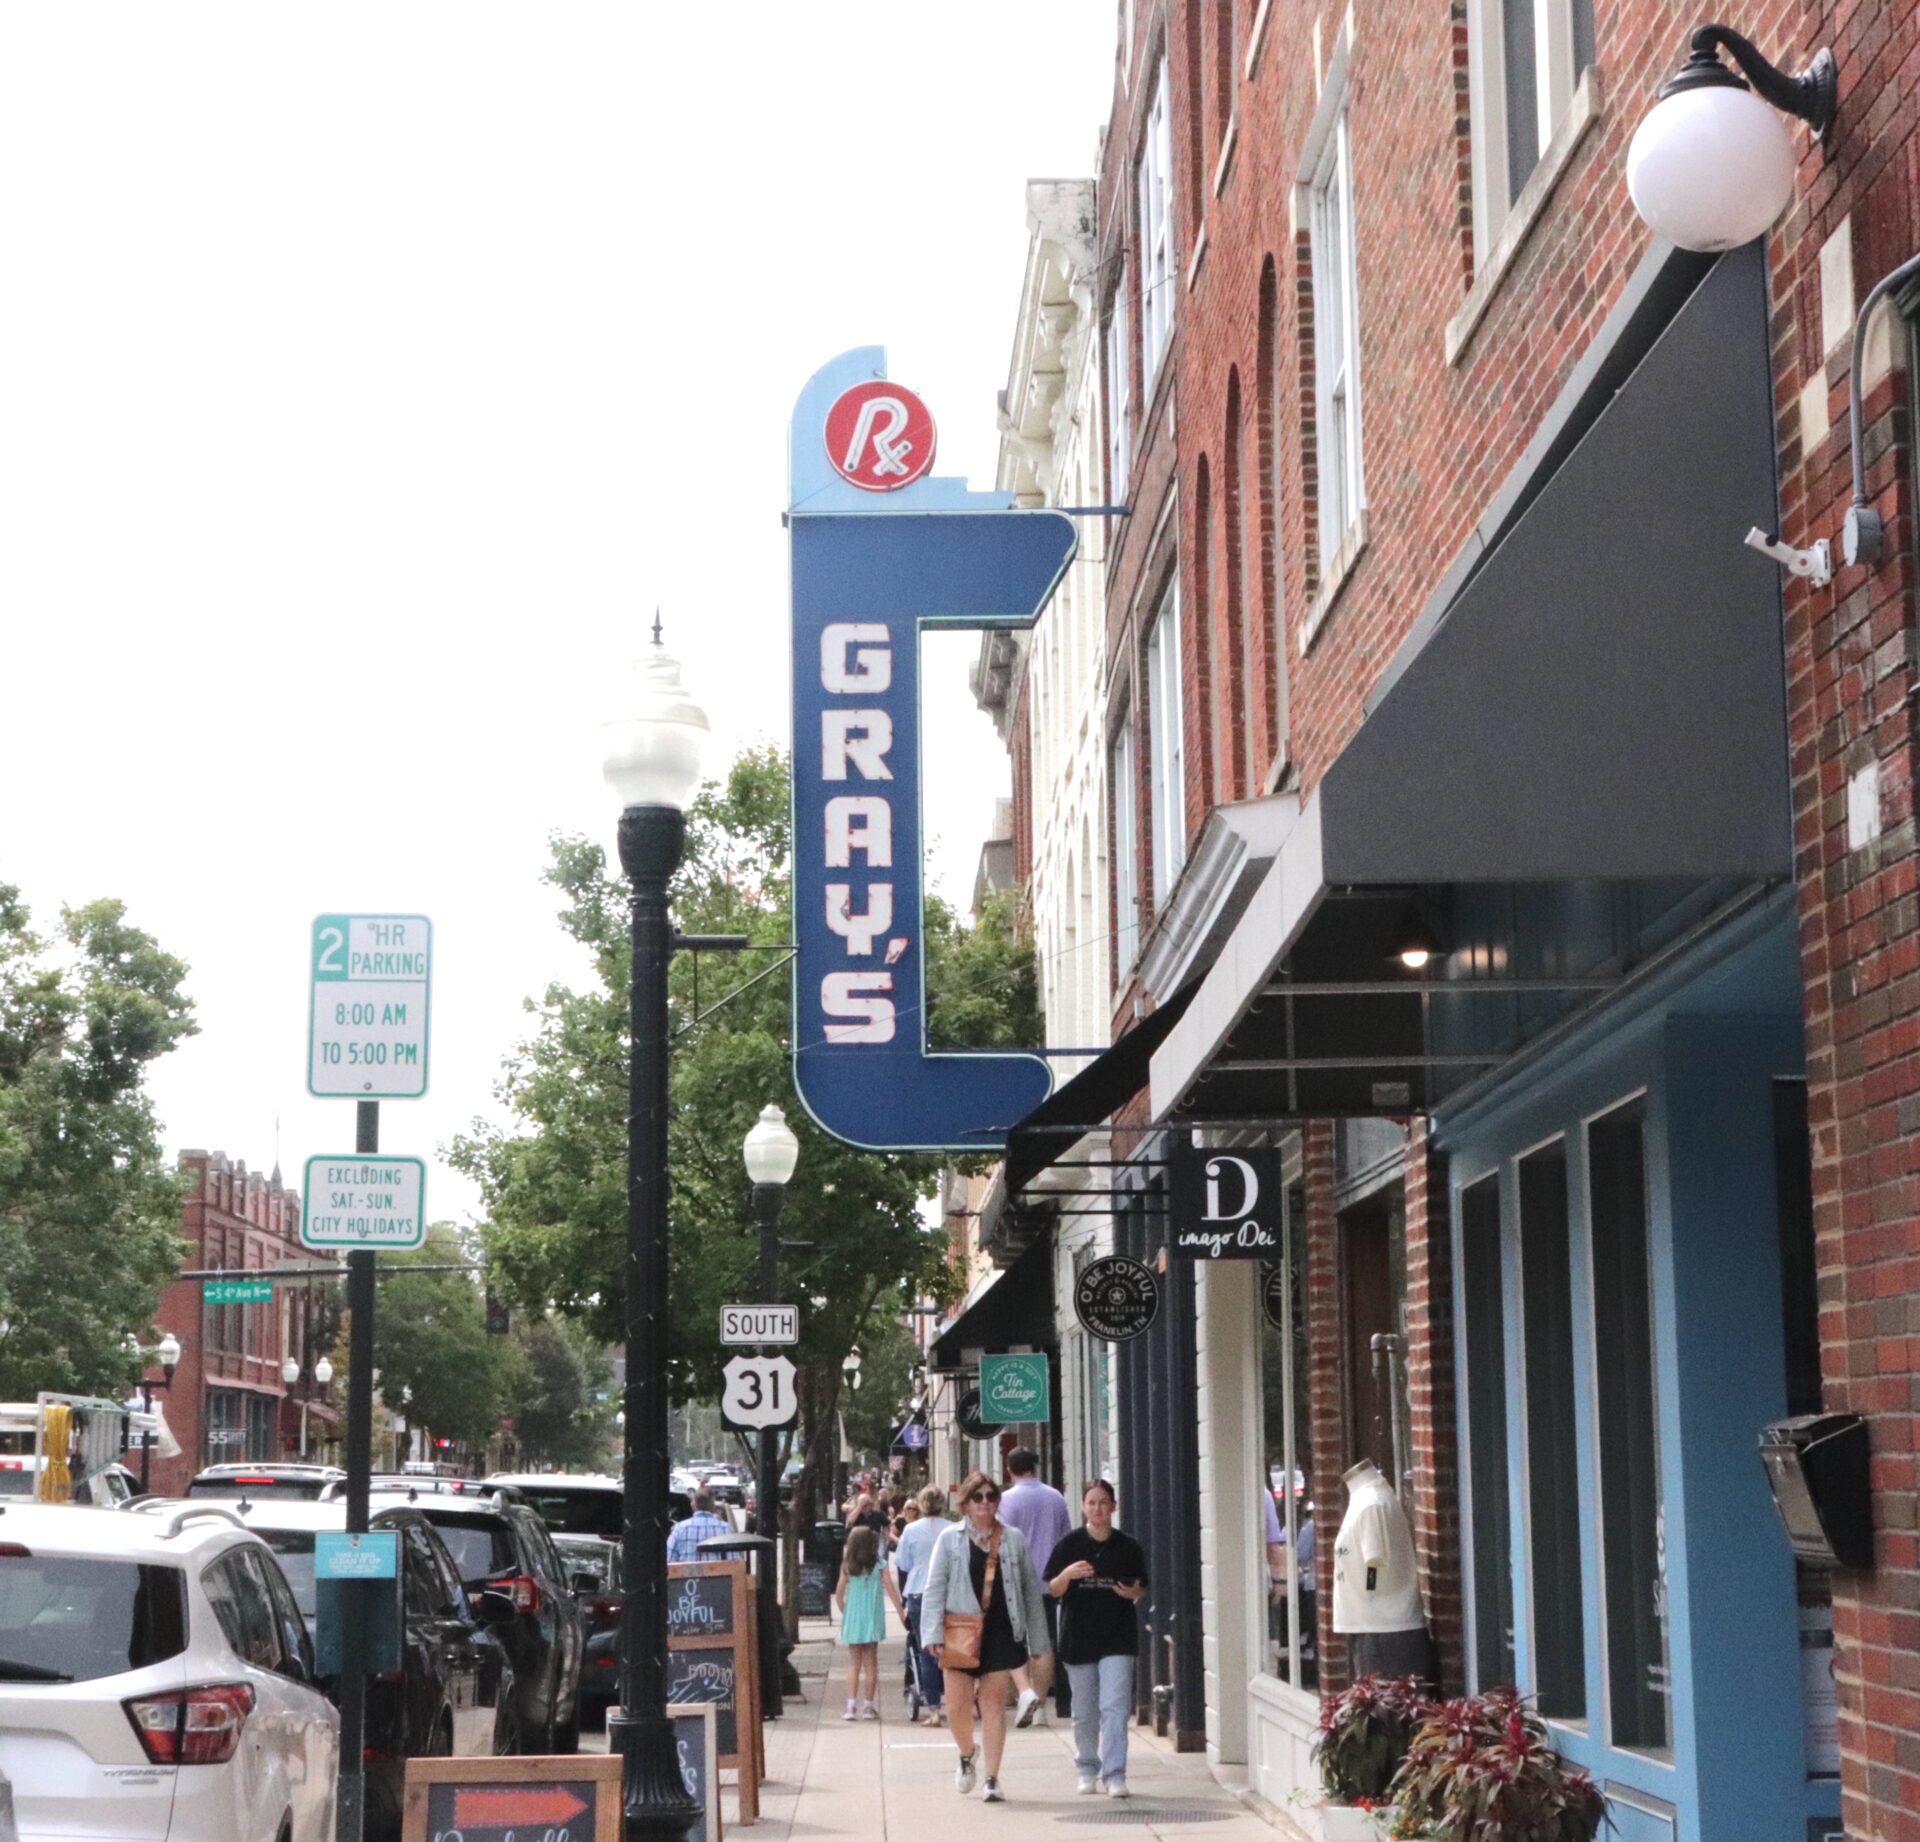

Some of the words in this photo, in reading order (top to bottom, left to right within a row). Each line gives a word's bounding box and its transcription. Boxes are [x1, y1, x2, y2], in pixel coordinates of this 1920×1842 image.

[820, 622, 910, 1044] GRAY'S
[317, 927, 344, 972] 2
[375, 923, 406, 946] HR
[351, 952, 425, 975] PARKING
[335, 1003, 375, 1025] 8:00
[381, 1003, 407, 1026] AM
[322, 1042, 341, 1064] TO
[348, 1042, 387, 1065] 5:00
[394, 1043, 417, 1065] PM
[327, 1167, 402, 1185] EXCLUDING
[312, 1216, 341, 1233] CITY
[347, 1217, 413, 1235] HOLIDAYS
[1178, 1227, 1234, 1258] imago
[1237, 1220, 1276, 1248] Dei
[1085, 1267, 1105, 1288] BE
[1106, 1262, 1154, 1301] JOYFUL
[215, 1287, 223, 1299] S
[236, 1287, 252, 1298] Ave
[253, 1286, 261, 1297] N
[726, 1312, 793, 1335] SOUTH
[1134, 1315, 1147, 1328] TN
[737, 1369, 779, 1411] 31
[1003, 1372, 1024, 1388] Tin
[991, 1385, 1037, 1403] Cottage
[208, 1431, 228, 1444] 55
[679, 1595, 701, 1610] BE
[666, 1606, 725, 1625] JOYFUL
